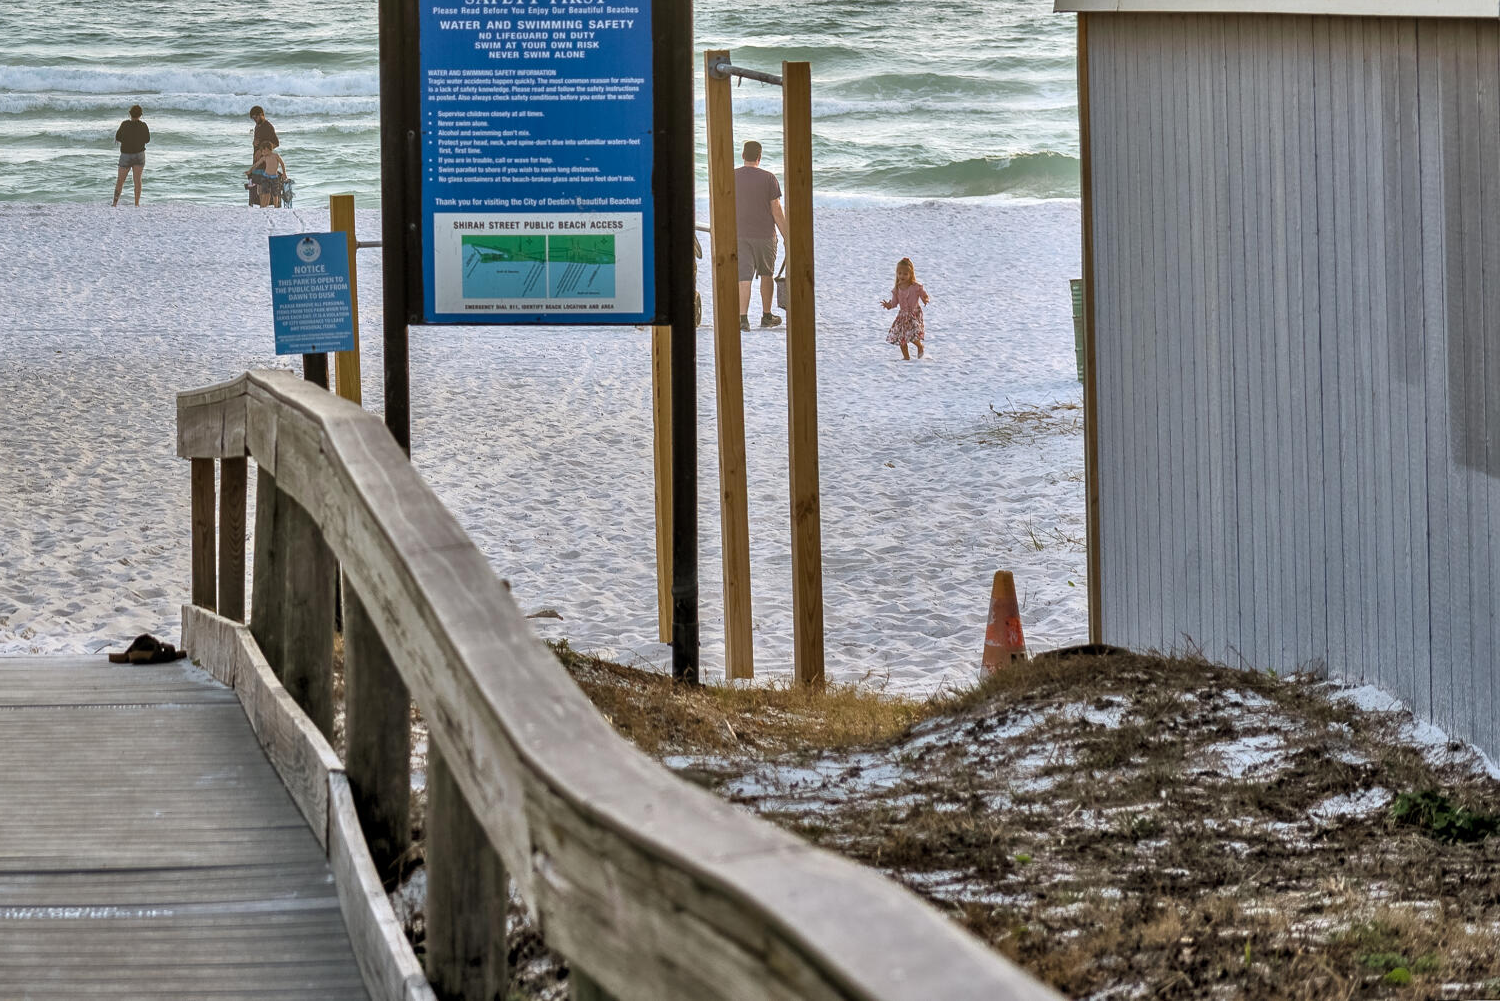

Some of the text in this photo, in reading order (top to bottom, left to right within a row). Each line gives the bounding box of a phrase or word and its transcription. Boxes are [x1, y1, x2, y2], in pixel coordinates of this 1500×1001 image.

[528, 6, 549, 15] Enjoy
[551, 6, 566, 14] Our
[568, 6, 604, 14] Beautiful
[439, 20, 634, 29] WATER AND SWIMMING SAFETY
[552, 32, 566, 40] ON
[570, 32, 595, 40] DUTY
[435, 197, 457, 205] Thank
[472, 197, 482, 205] for
[484, 197, 510, 206] visiting
[510, 197, 522, 205] the
[523, 197, 537, 206] City
[538, 197, 546, 205] of
[576, 197, 609, 205] Beautiful
[609, 197, 642, 205] Beaches!
[453, 221, 623, 229] SHIRAH STREET PUBLIC BEACH ACCESS
[294, 265, 325, 274] NOTICE
[317, 276, 334, 284] OPEN
[288, 293, 308, 301] DAWN
